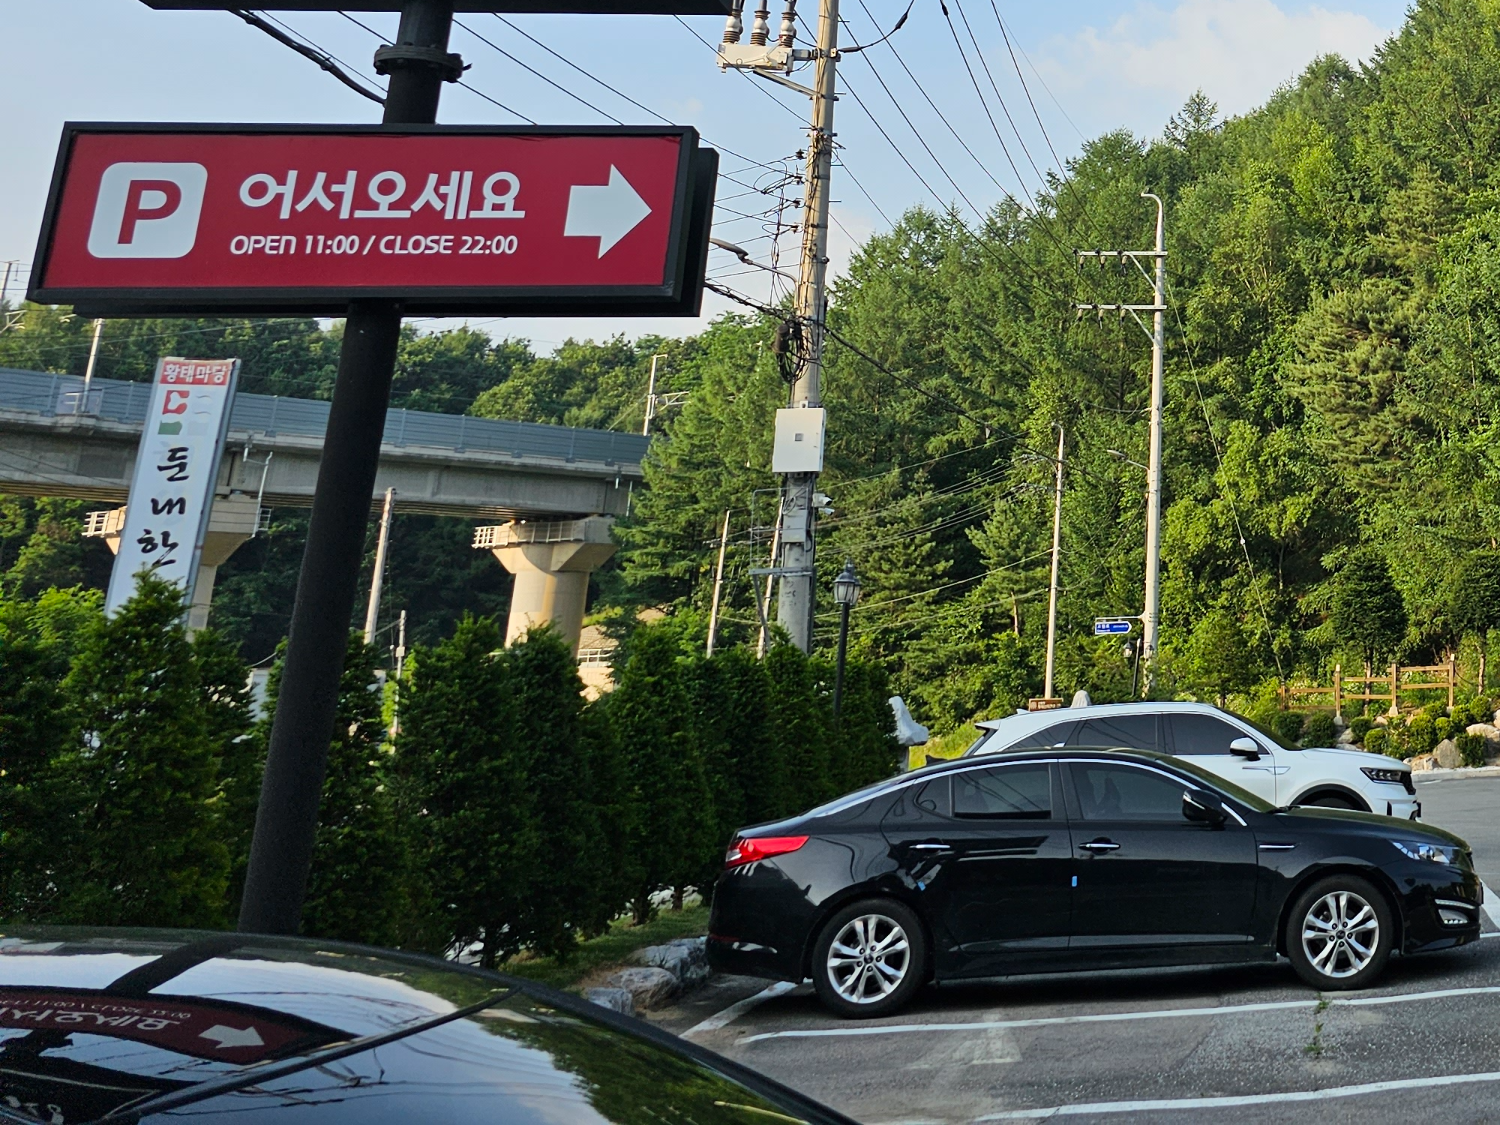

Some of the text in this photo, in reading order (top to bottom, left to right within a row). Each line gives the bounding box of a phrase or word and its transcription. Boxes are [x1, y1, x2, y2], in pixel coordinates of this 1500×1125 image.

[117, 179, 182, 245] P
[239, 170, 526, 220] 어서오세요
[230, 235, 297, 255] OPEN
[305, 235, 359, 255] 11:00
[379, 235, 454, 255] CLOSE
[459, 235, 518, 255] 22:00
[164, 363, 228, 383] 황태마당
